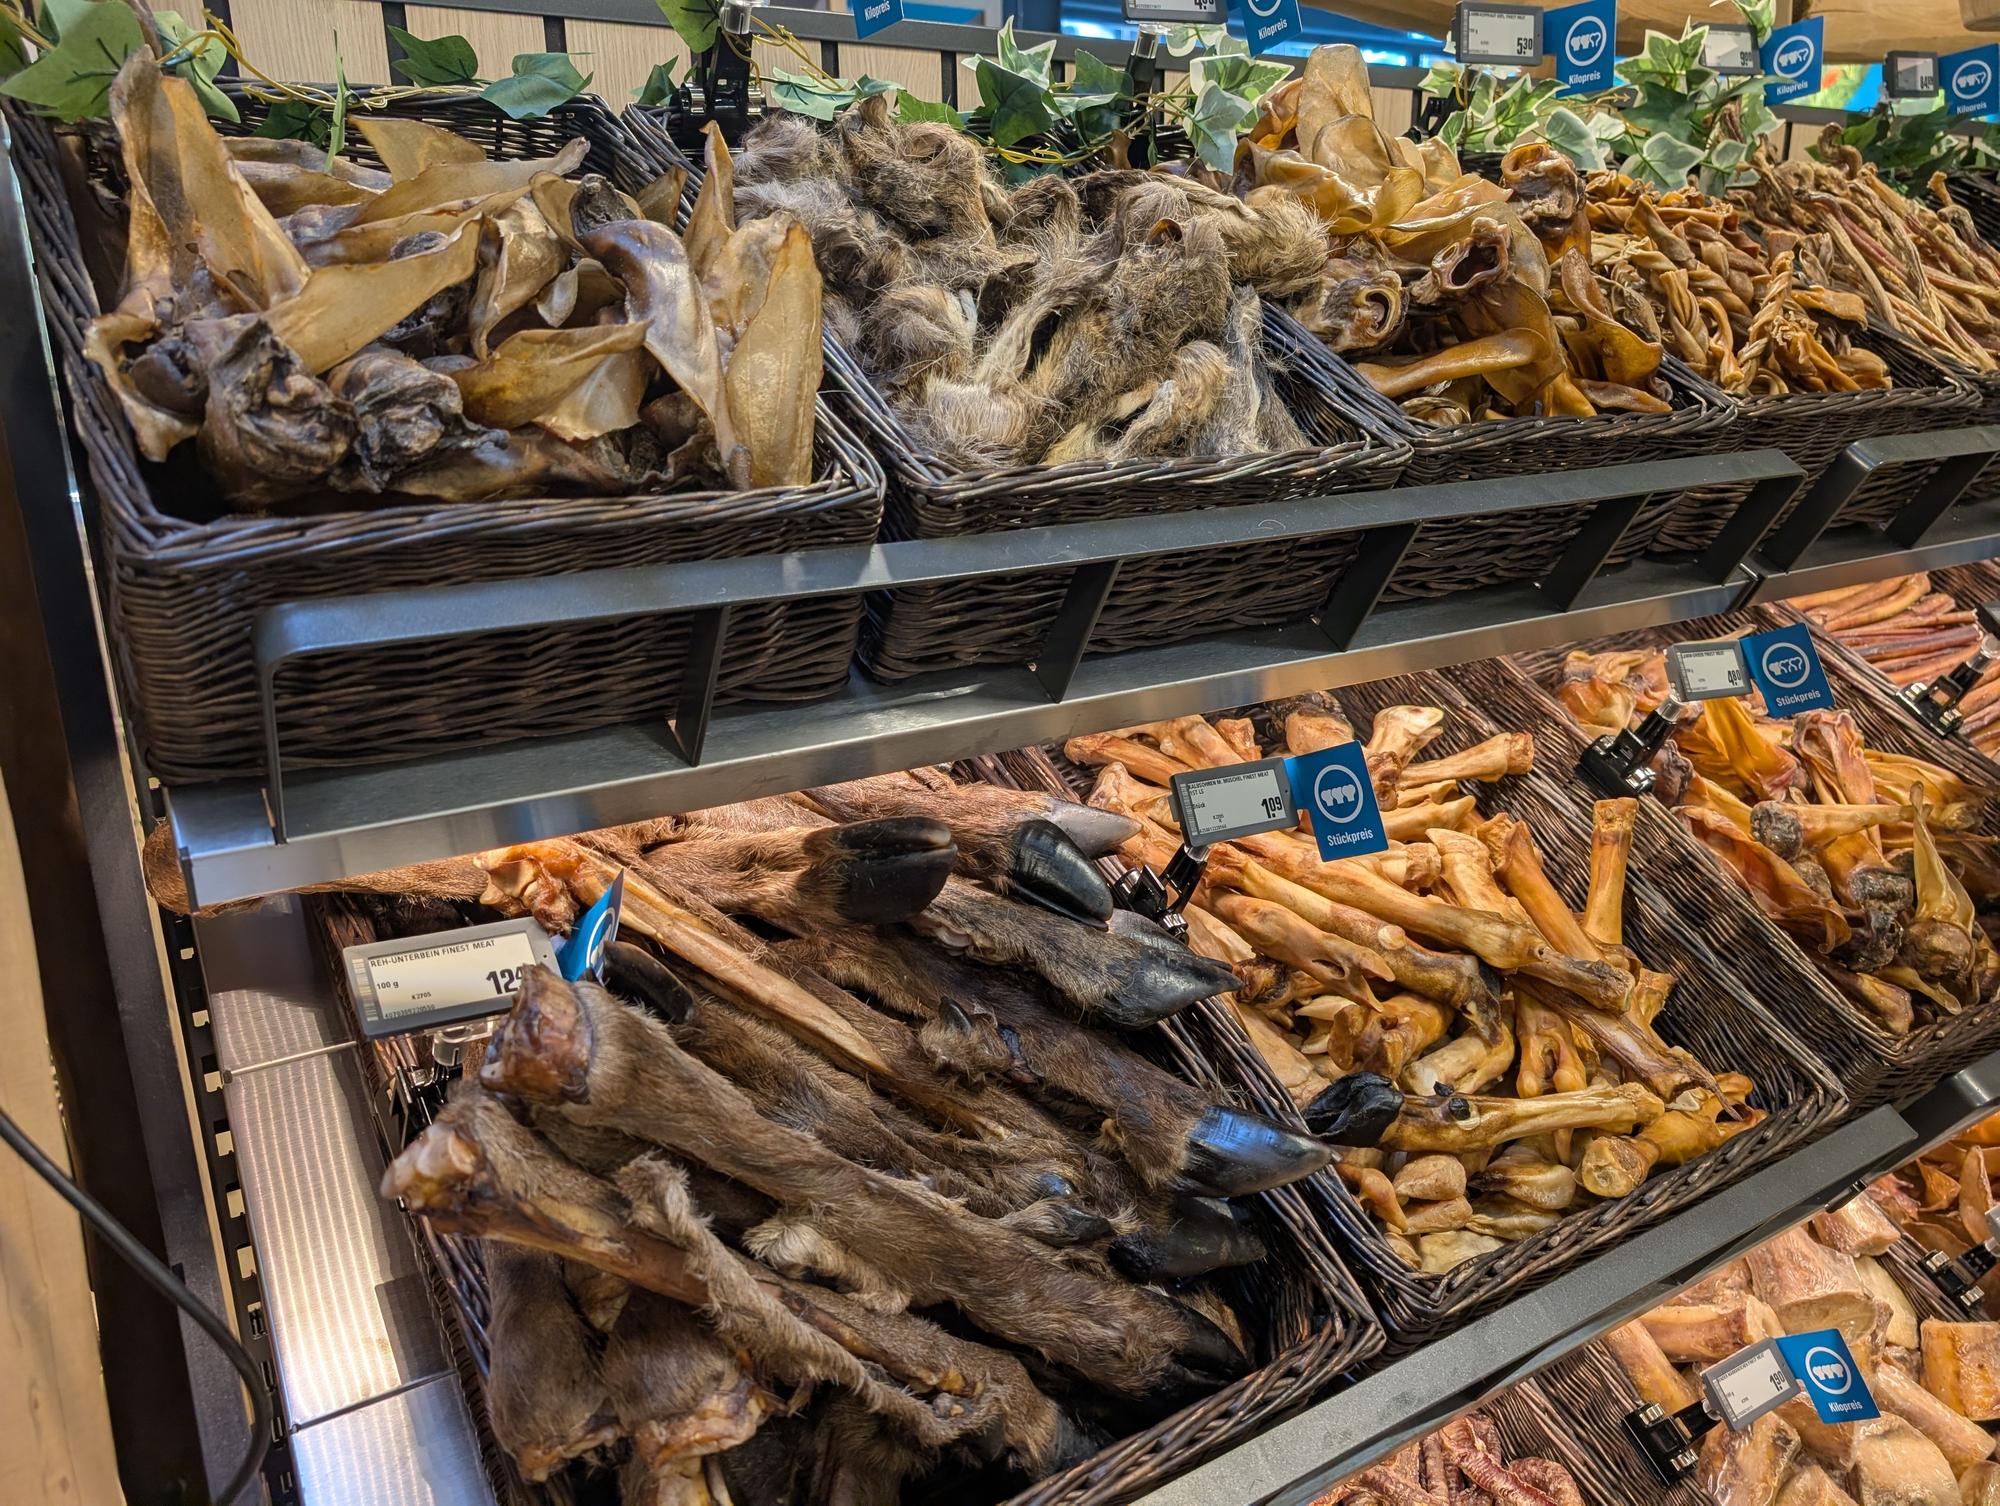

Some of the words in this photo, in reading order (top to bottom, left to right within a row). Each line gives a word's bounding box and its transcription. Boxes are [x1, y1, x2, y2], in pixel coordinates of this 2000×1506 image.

[864, 0, 890, 21] Kilopreis
[1258, 18, 1288, 40] Kilopreis
[1516, 37, 1533, 55] 5.30
[1568, 70, 1601, 85] Kilopreis
[1776, 80, 1808, 95] Kilopreis
[1956, 102, 1987, 115] Kilopreis
[1727, 669, 1742, 686] 4.80
[1776, 689, 1821, 707] Stückpreis
[1261, 796, 1283, 819] 1.09
[1327, 828, 1374, 847] Stückpreis
[370, 949, 440, 968] REH-UNTERBEIN
[442, 944, 471, 956] FINEST
[473, 939, 496, 950] MEAT
[376, 981, 392, 990] 100
[392, 981, 400, 989] g
[1769, 1370, 1786, 1392] 1.90
[1828, 1399, 1863, 1413] Kilopreis
